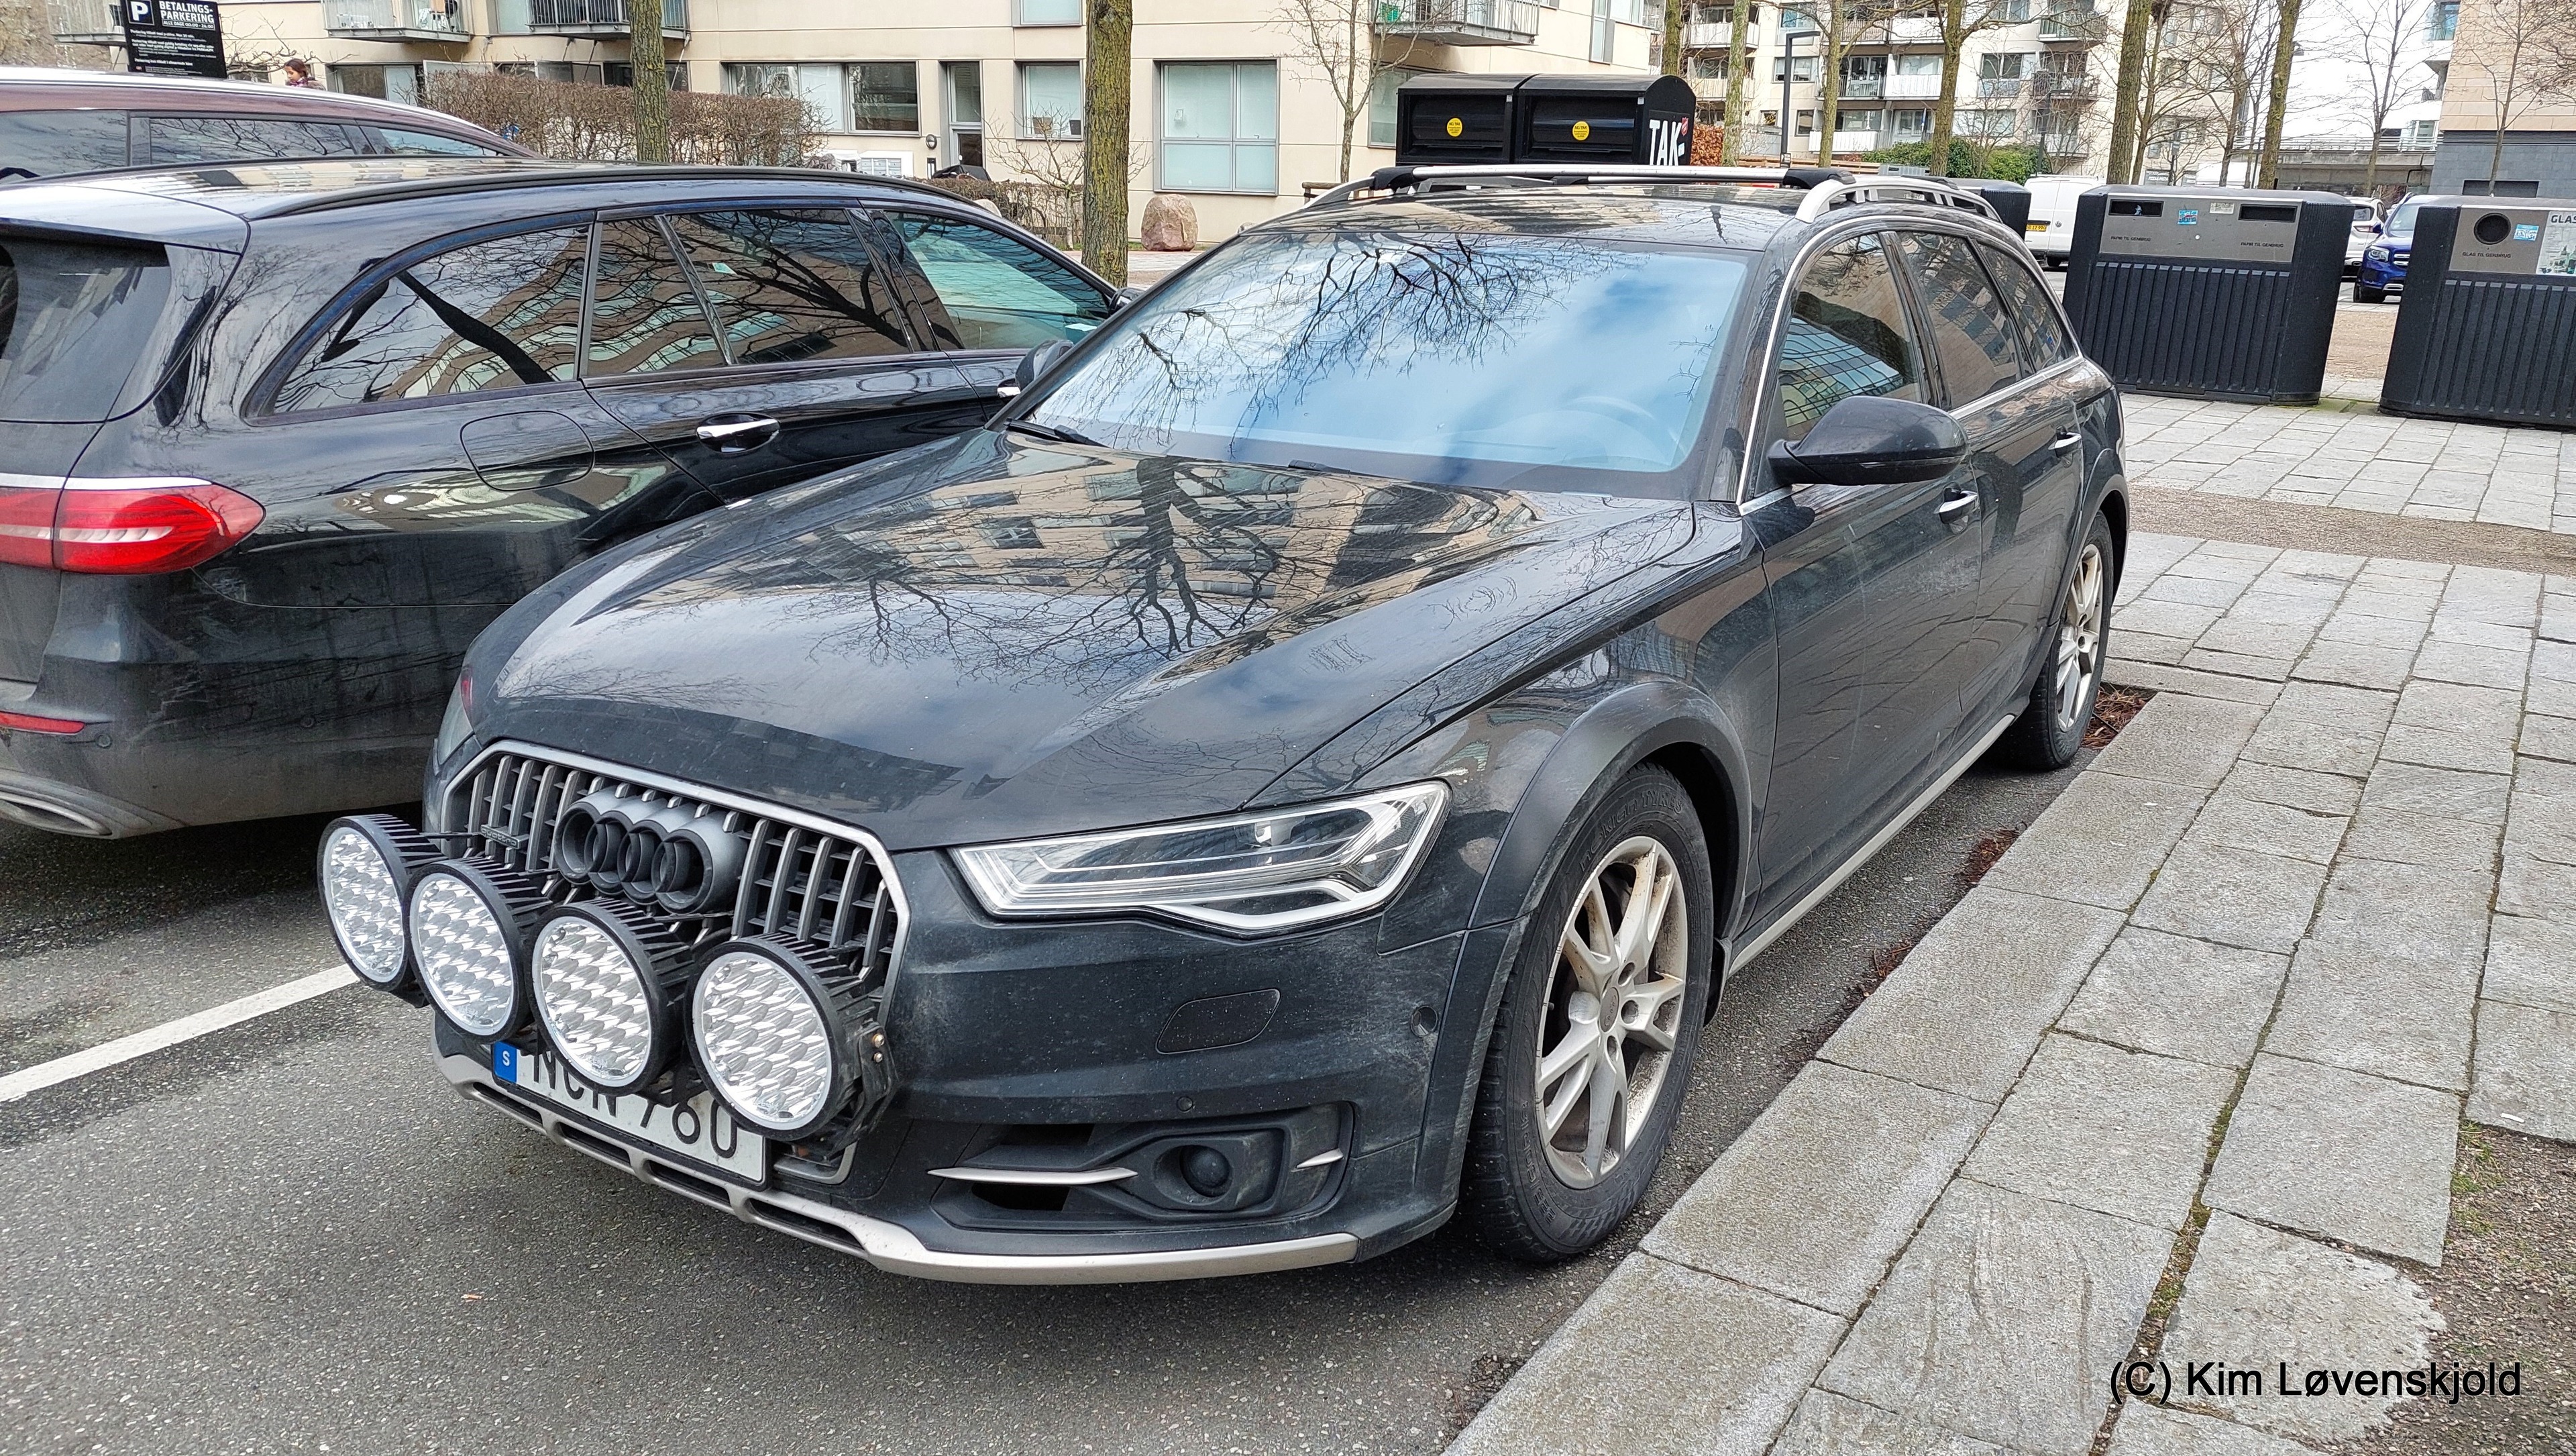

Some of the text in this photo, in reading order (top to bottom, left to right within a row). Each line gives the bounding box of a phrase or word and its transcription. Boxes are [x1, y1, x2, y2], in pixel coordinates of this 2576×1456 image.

[130, 1, 148, 21] P
[159, 1, 213, 13] BETALINGS-
[160, 10, 214, 23] PARKERING
[1650, 119, 1682, 166] TAK
[502, 1051, 511, 1067] S
